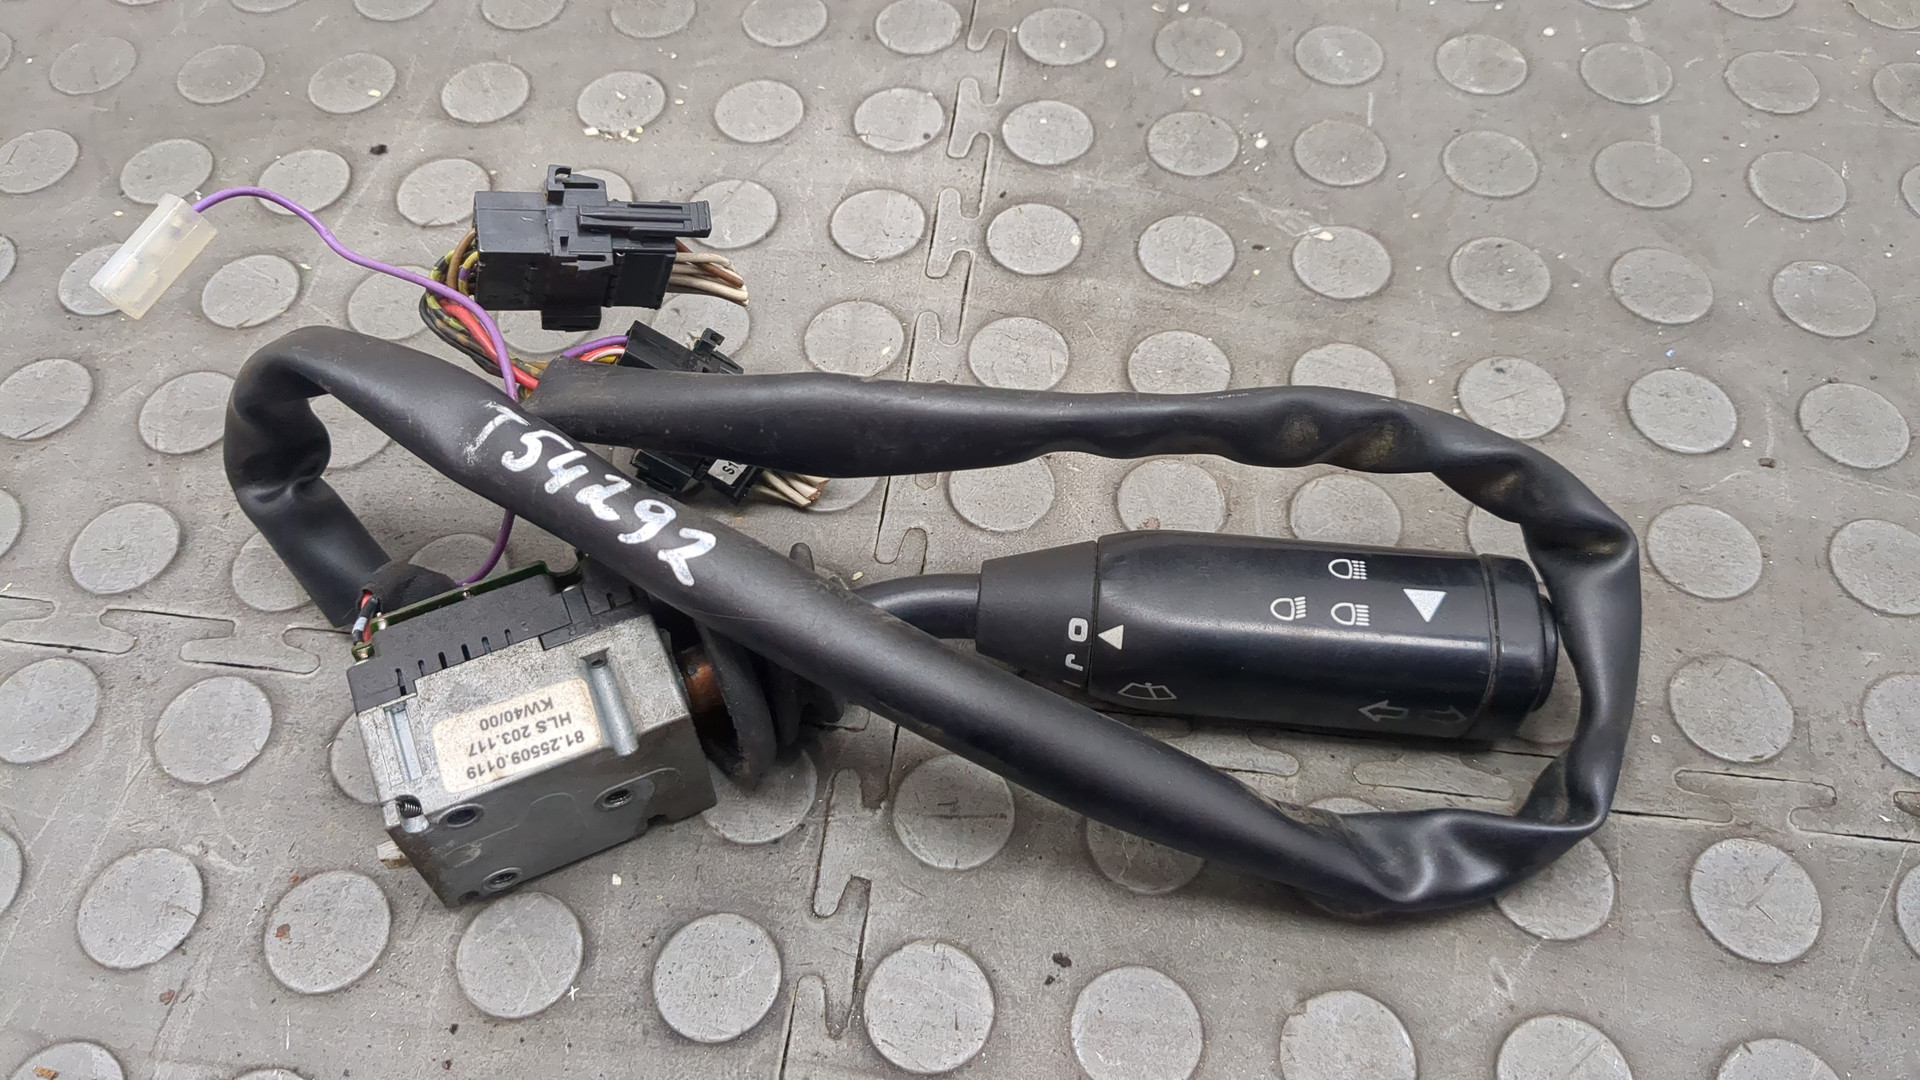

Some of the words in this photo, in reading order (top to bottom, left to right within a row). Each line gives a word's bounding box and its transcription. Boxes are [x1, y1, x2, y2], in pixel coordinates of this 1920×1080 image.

[480, 697, 554, 731] KW40/00
[536, 712, 572, 733] HLS
[467, 730, 585, 779] 81.25509.0119
[468, 725, 531, 757] 203.117
